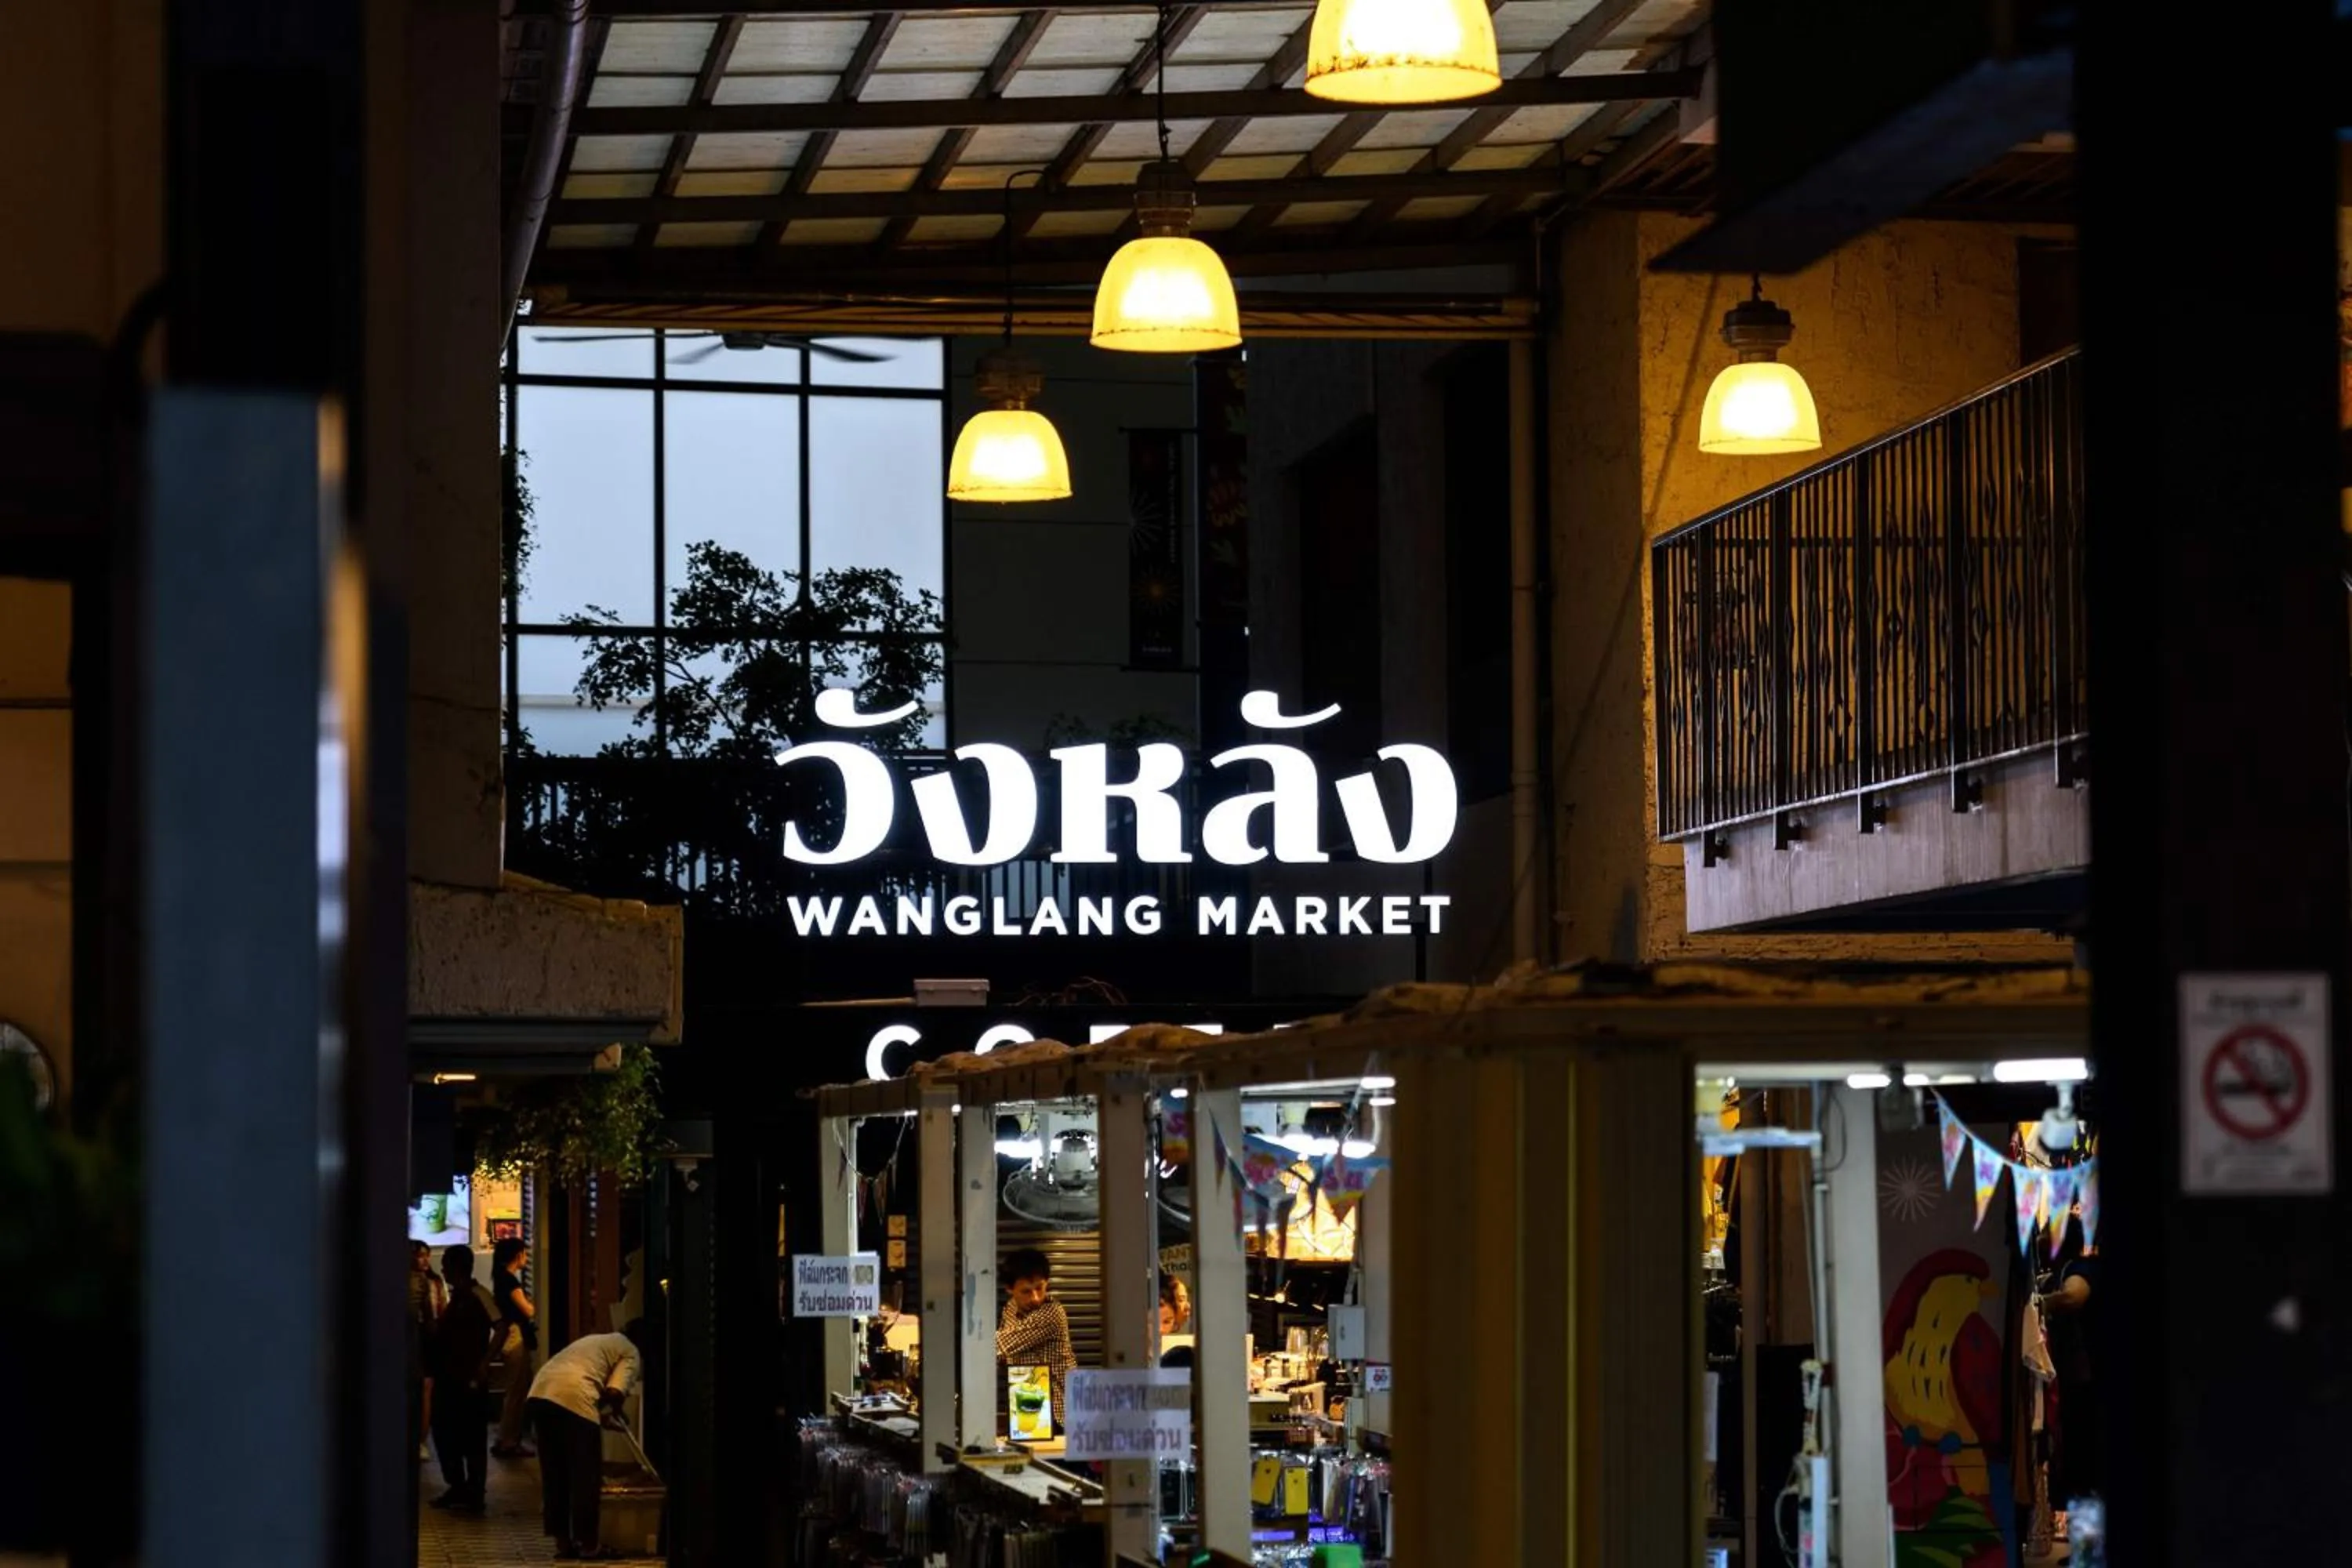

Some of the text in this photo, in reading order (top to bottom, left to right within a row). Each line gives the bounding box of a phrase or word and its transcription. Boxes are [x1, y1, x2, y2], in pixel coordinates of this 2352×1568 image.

[775, 688, 1457, 865] วังหลัง
[786, 895, 1450, 936] WANGLANG MARKET
